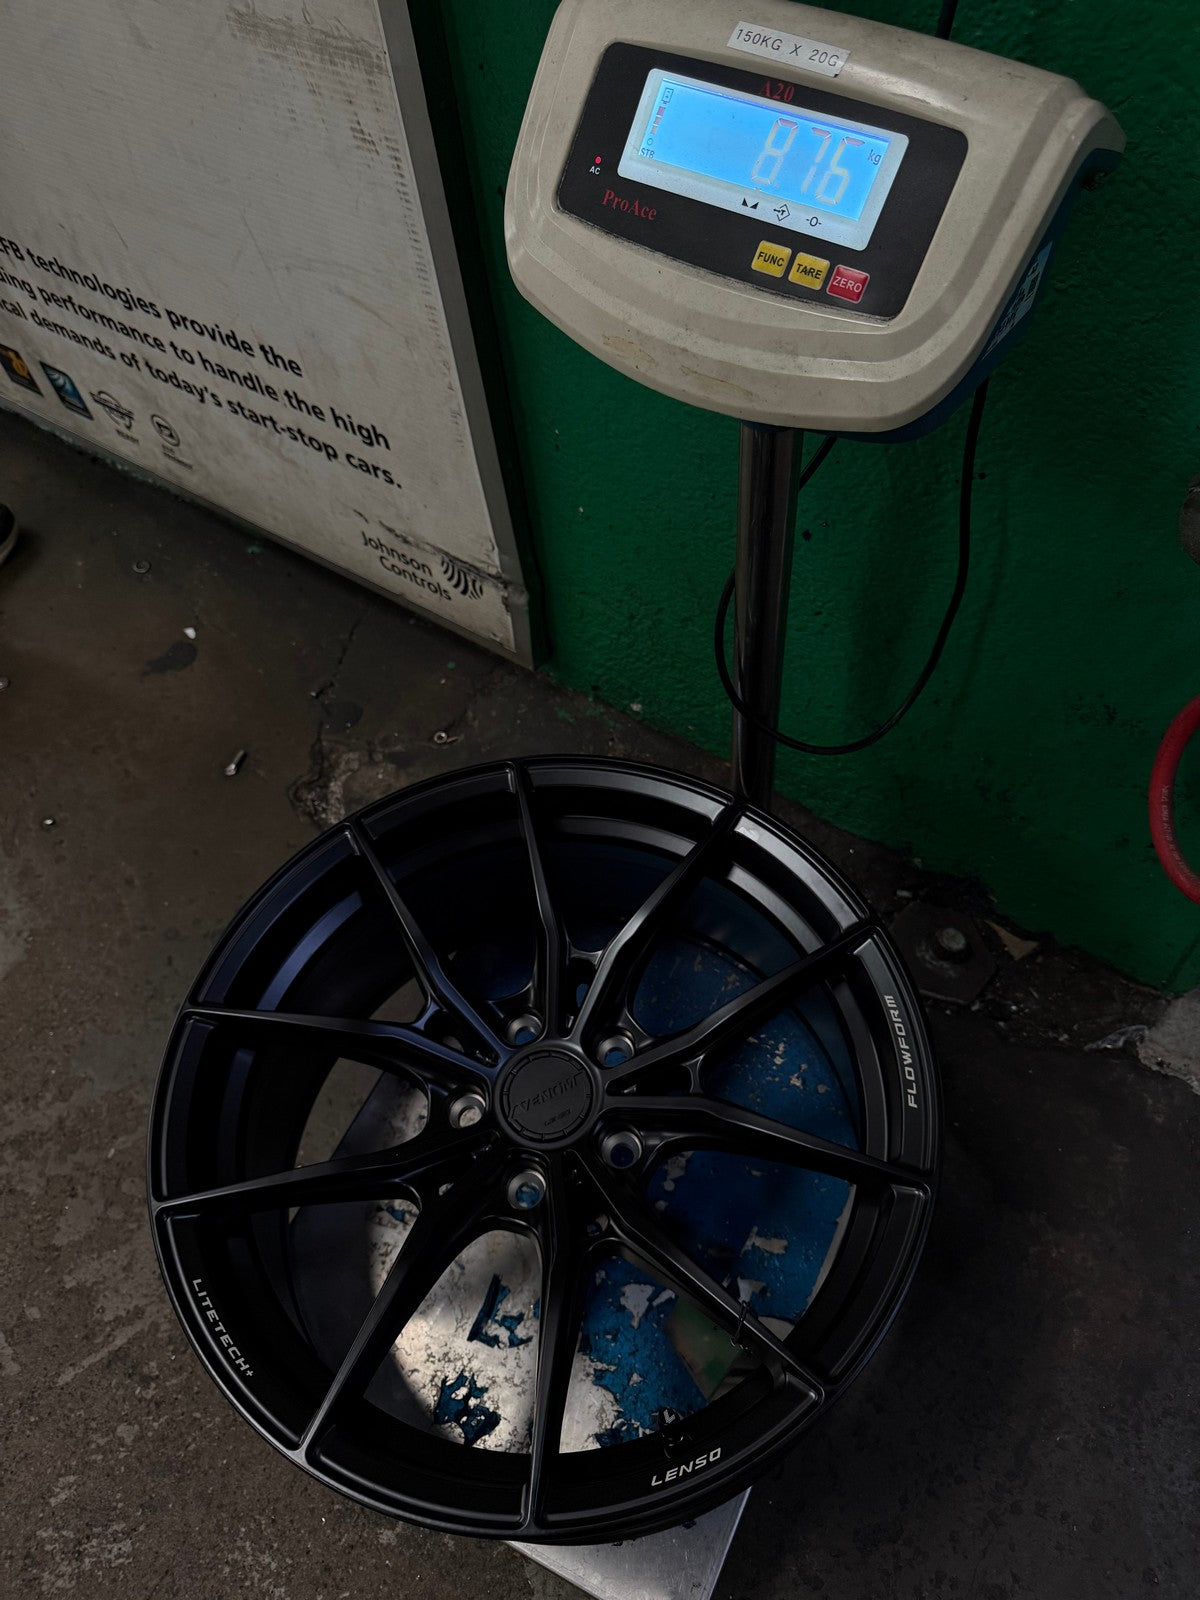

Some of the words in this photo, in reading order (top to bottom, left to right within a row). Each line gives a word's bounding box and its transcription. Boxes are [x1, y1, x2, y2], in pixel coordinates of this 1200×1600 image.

[736, 28, 784, 52] 150KG
[789, 44, 802, 57] X
[808, 48, 840, 68] 20G
[758, 80, 796, 103] A20
[589, 165, 601, 176] AC
[640, 146, 655, 160] STB
[867, 149, 882, 165] kg
[601, 187, 658, 222] ProAce
[756, 250, 786, 268] FUNC
[796, 263, 823, 281] TARE
[832, 276, 863, 294] ZERO
[0, 236, 25, 261] FB
[26, 248, 162, 319] technologies
[165, 308, 256, 358] provide
[259, 344, 303, 377] the
[37, 286, 167, 353] performance
[169, 340, 195, 365] to
[197, 350, 280, 402] handle
[283, 389, 326, 422] the
[329, 406, 392, 451] high
[30, 308, 116, 360] demands
[119, 353, 142, 372] of
[144, 359, 223, 408] today's
[227, 399, 338, 462] start-stop
[345, 452, 403, 489] cars.
[361, 530, 434, 578] Johnson
[379, 555, 452, 601] Controls
[883, 994, 919, 1109] FLOWFORM
[650, 1446, 722, 1487] LENSO
